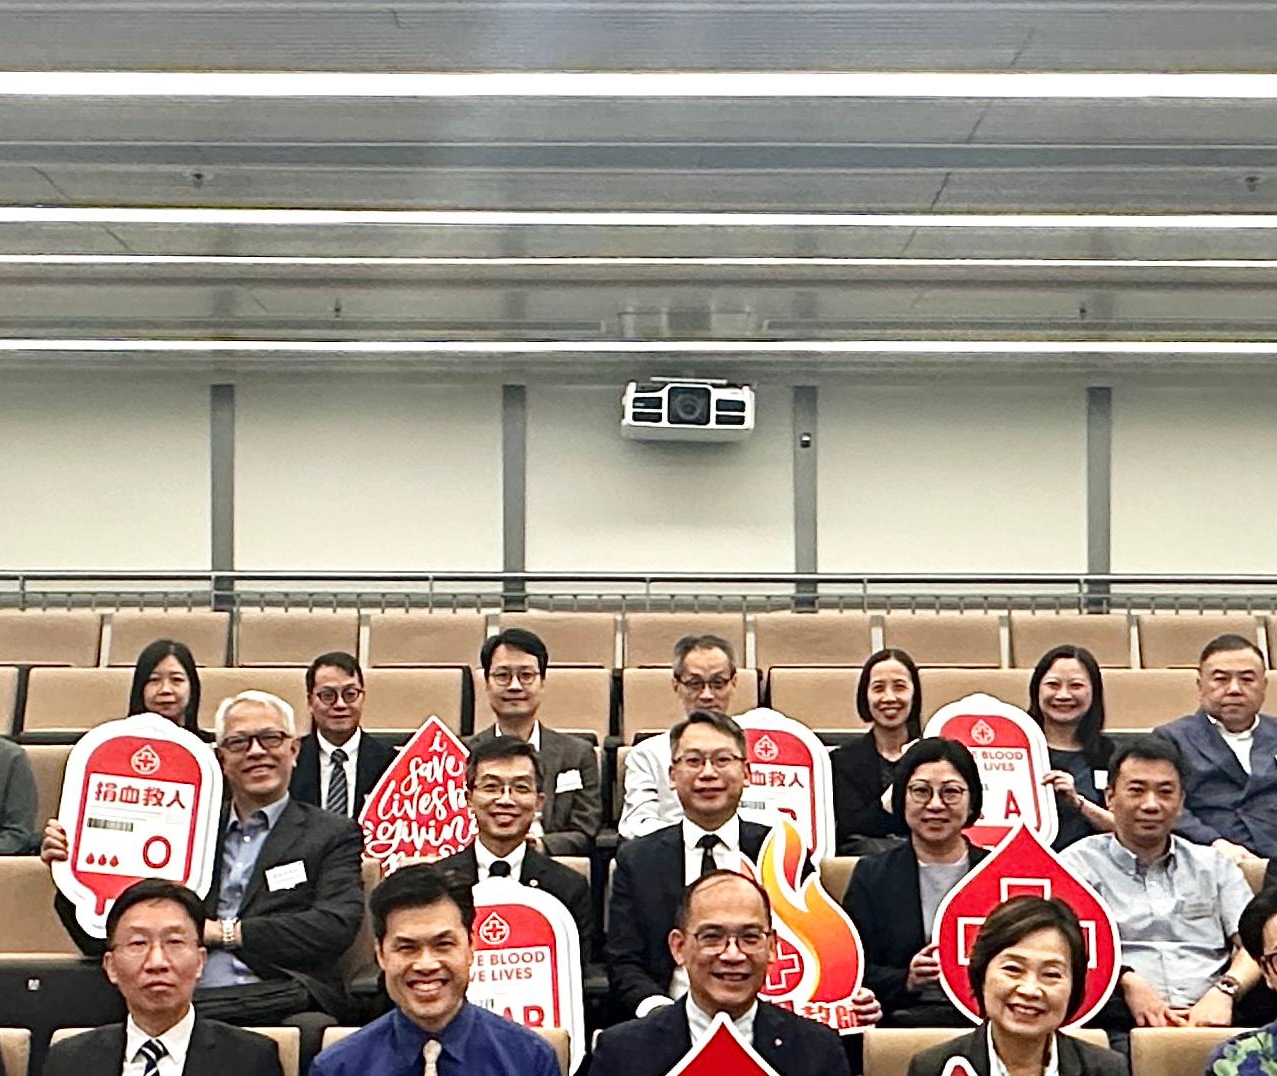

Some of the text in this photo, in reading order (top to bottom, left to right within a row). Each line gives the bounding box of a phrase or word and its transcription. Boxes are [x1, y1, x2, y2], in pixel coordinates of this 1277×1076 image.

[981, 751, 1024, 760] BLOOD
[400, 751, 466, 796] save
[95, 781, 186, 810] 捐血救人
[377, 779, 448, 822] lives
[1004, 789, 1022, 819] A
[143, 835, 172, 869] O
[490, 951, 545, 966] BLOOD
[491, 967, 533, 981] LIVES
